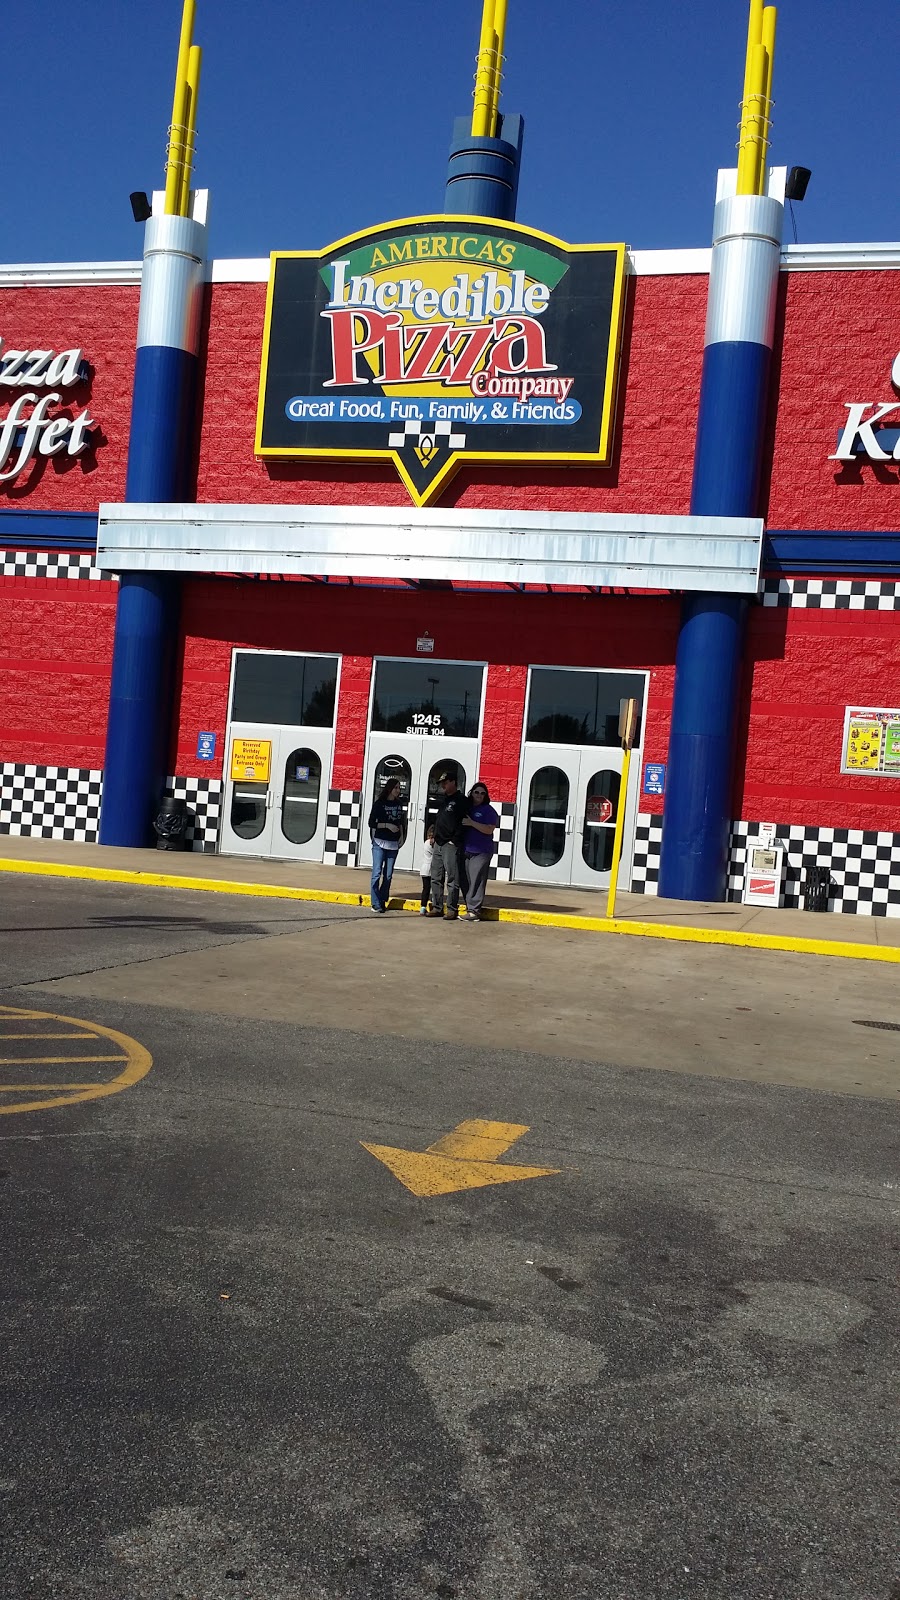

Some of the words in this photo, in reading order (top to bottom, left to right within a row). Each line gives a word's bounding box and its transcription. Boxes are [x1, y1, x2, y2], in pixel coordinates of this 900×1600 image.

[370, 236, 517, 269] AMERICA'S
[328, 259, 551, 322] Incredible
[320, 308, 558, 388] Pizza
[0, 346, 83, 387] zza
[471, 371, 574, 404] Company
[289, 400, 335, 419] Great
[339, 400, 386, 420] Food,
[390, 402, 422, 420] Fun,
[429, 402, 487, 422] Family,
[491, 403, 509, 419] &
[512, 402, 575, 420] Friends
[406, 726, 429, 736] SUITE
[431, 728, 445, 737] 104
[411, 713, 442, 726] 1245
[586, 802, 610, 811] EXIT
